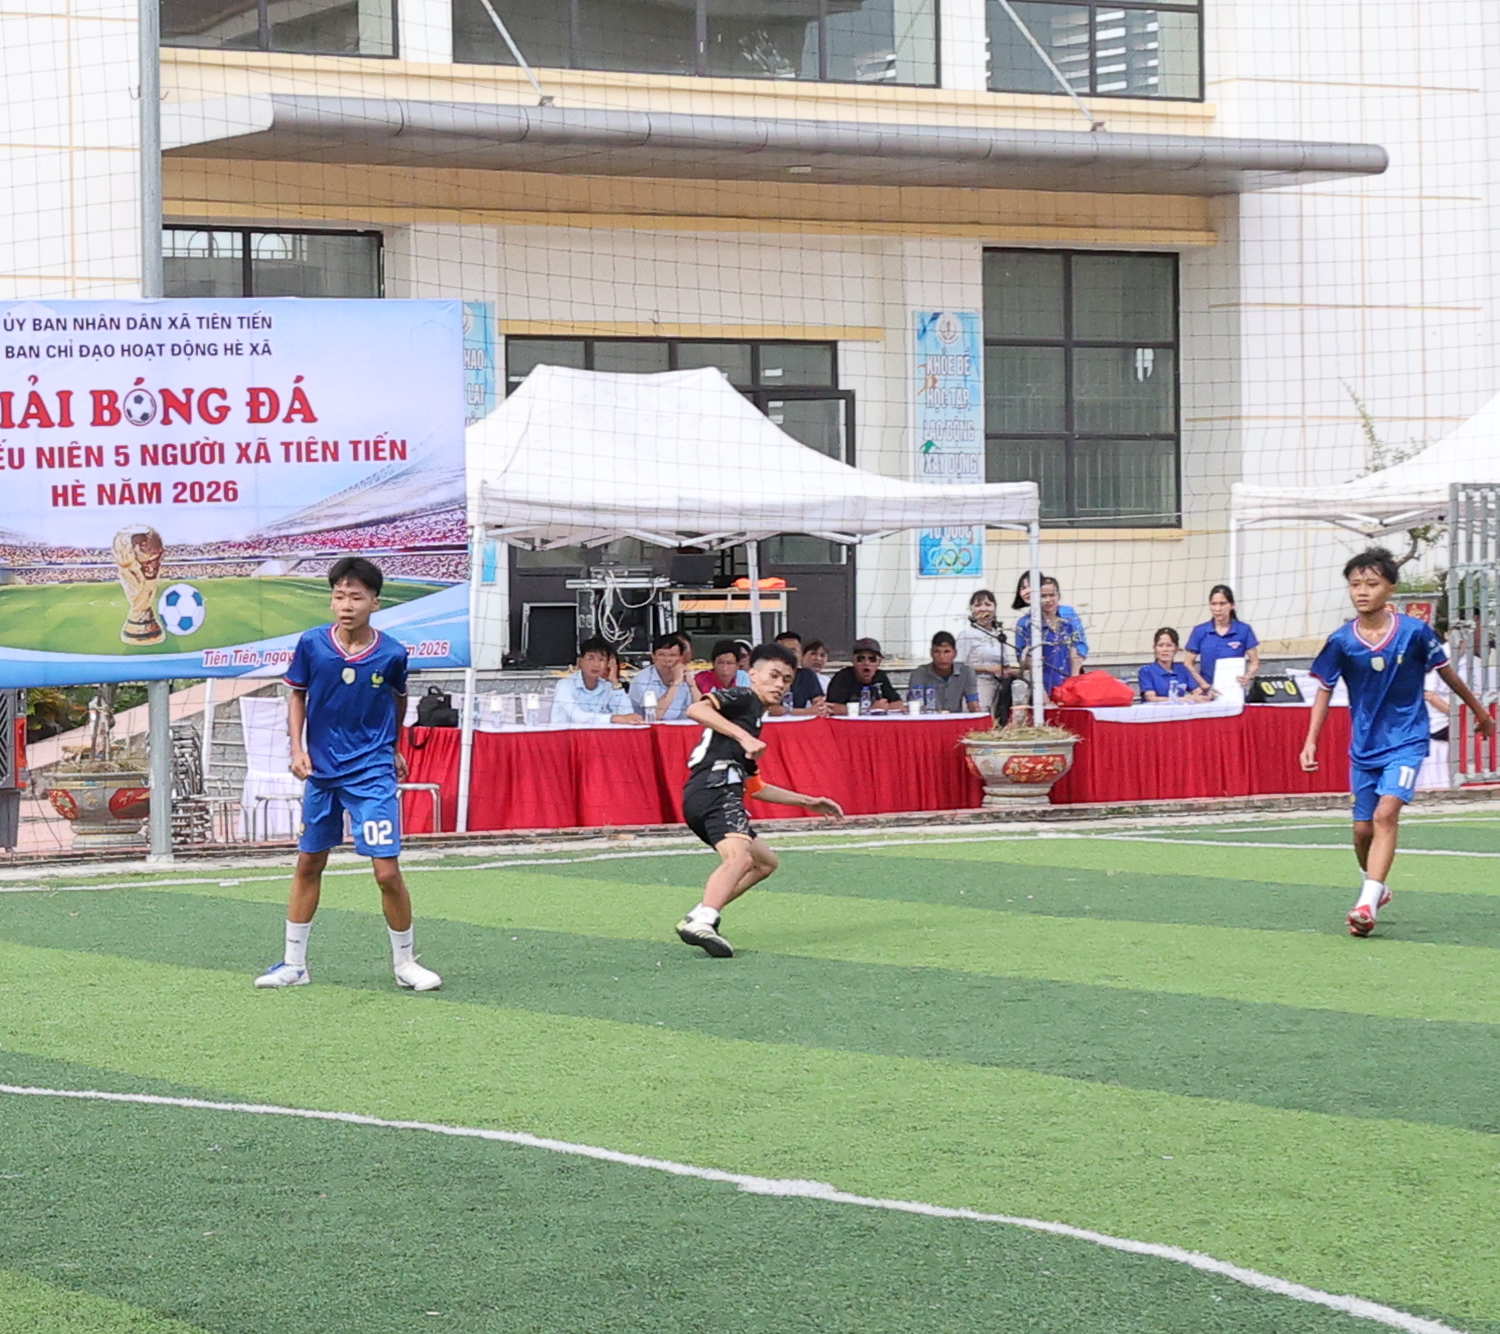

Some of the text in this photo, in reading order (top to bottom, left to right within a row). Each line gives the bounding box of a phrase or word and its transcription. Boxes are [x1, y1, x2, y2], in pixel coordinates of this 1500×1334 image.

[3, 310, 273, 332] ỦY BAN NHÂN DÂN XÃ TIÊN TIẾN
[5, 338, 273, 362] BAN CHỈ ĐẠO HOẠT ĐỘNG HÈ XÃ
[463, 348, 485, 371] HAO
[925, 347, 956, 377] KHỎE
[89, 377, 231, 427] BÓNG
[245, 375, 318, 424] ĐÁ
[925, 387, 948, 413] HỌC
[36, 441, 104, 469] NIÊN
[114, 445, 131, 467] 5
[140, 436, 225, 467] NGƯỜI
[235, 437, 272, 464] XÃ
[280, 436, 340, 463] TIÊN
[348, 431, 408, 461] TIẾN
[51, 478, 239, 507] HÈ NĂM 2026
[204, 651, 229, 665] Tiên
[418, 641, 449, 656] 2026
[363, 820, 394, 847] 02
